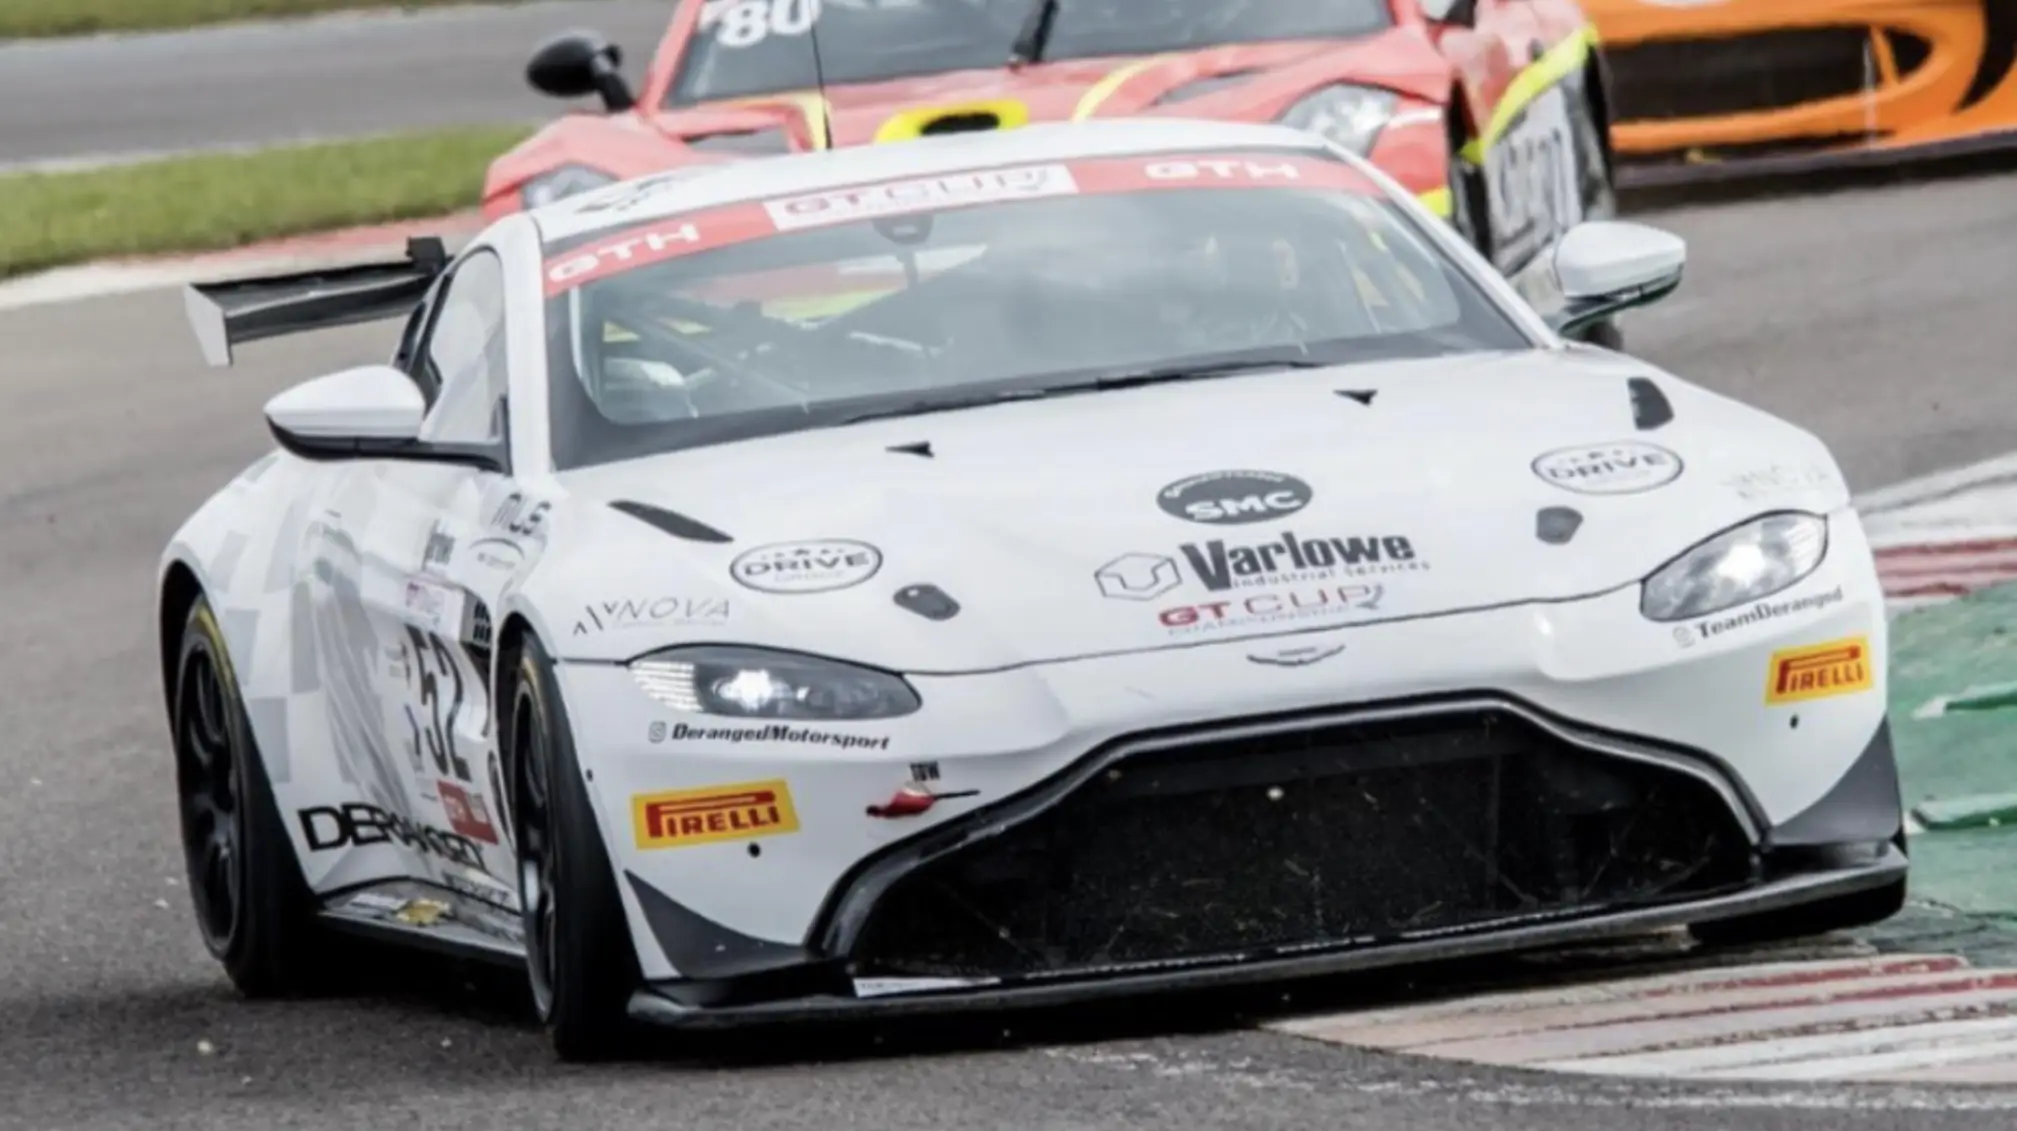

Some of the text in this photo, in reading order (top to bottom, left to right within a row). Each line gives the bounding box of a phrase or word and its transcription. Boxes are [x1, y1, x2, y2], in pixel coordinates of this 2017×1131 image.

[1144, 160, 1300, 180] GTH
[549, 223, 700, 282] GTH
[1547, 452, 1669, 480] DRIVE
[1185, 490, 1302, 521] SMC
[744, 552, 869, 576] DRIVE
[1179, 531, 1416, 592] Varlowe
[1159, 584, 1372, 628] GT CUP
[1695, 584, 1844, 640] TeamDeranged
[1775, 645, 1866, 695] PIRELLI
[404, 622, 473, 784] 52
[671, 722, 890, 751] DerangedMotorsport
[645, 790, 781, 838] PIRELLI
